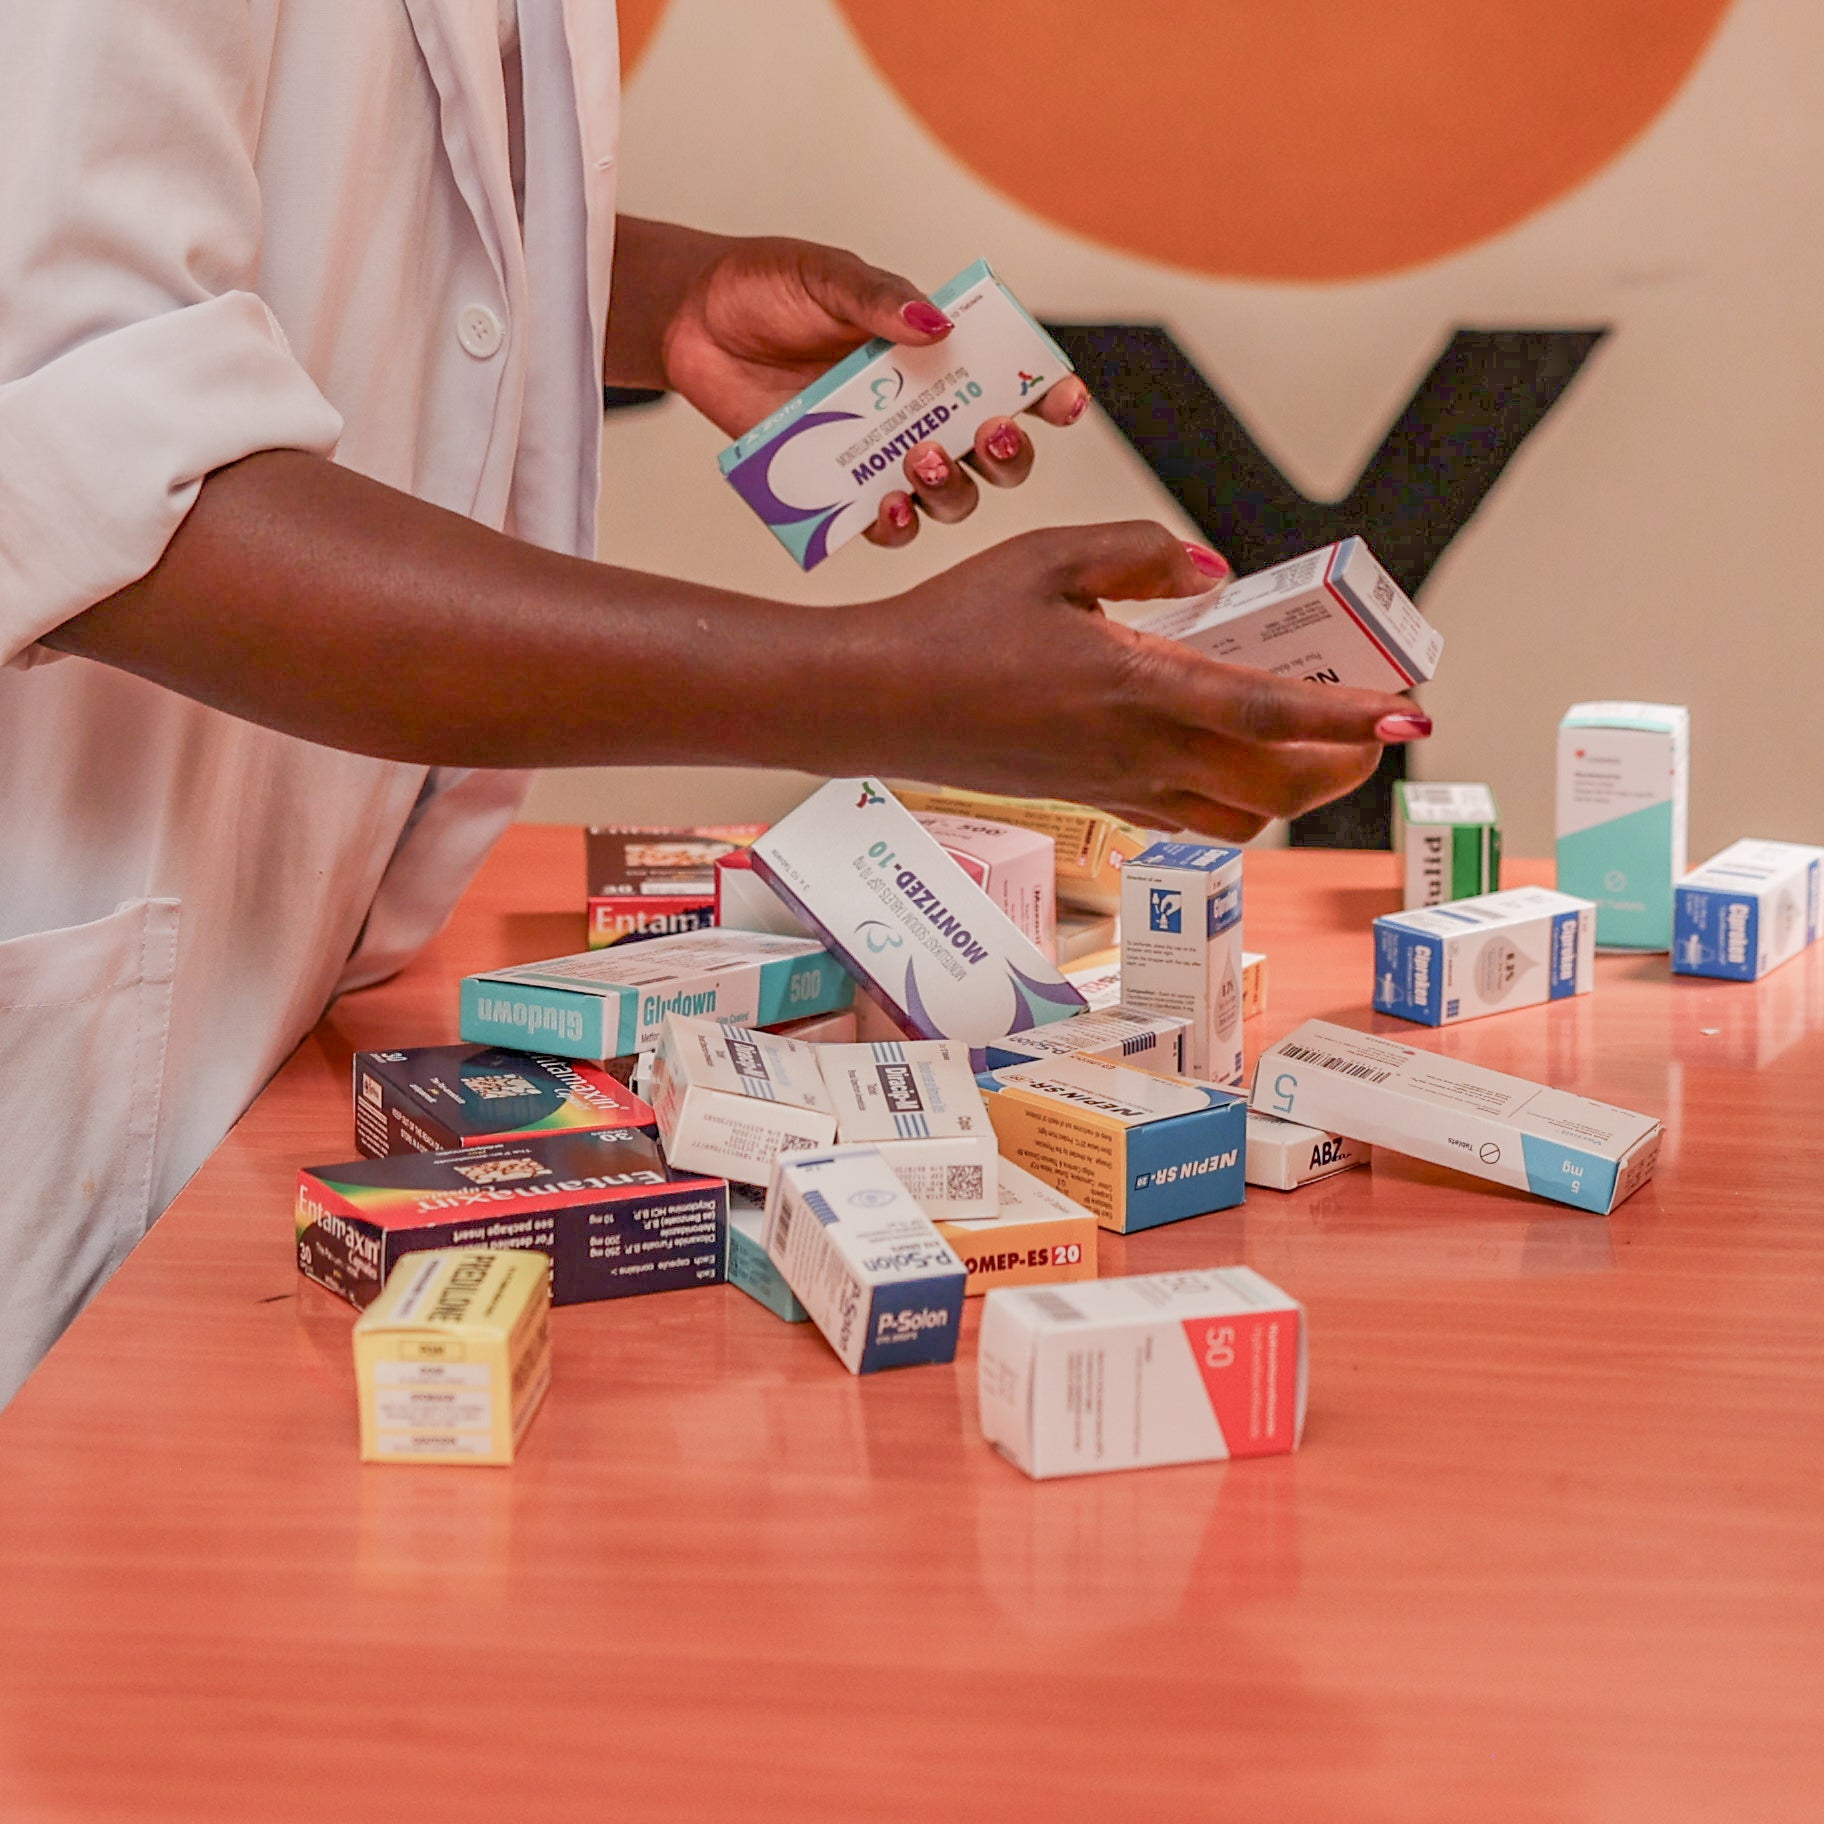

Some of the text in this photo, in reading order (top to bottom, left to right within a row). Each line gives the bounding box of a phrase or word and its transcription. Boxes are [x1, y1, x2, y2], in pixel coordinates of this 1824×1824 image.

[789, 969, 821, 1003] 500
[477, 997, 584, 1041] Gludown
[884, 1065, 921, 1111] Diracip-M
[1447, 1136, 1474, 1151] Tablets
[1179, 1149, 1238, 1180] NEPIN
[1561, 1160, 1584, 1178] mg
[298, 1184, 381, 1266] Entamaxin
[1055, 1245, 1080, 1265] 20
[879, 1306, 949, 1336] P-Solon
[1204, 1326, 1236, 1369] 50
